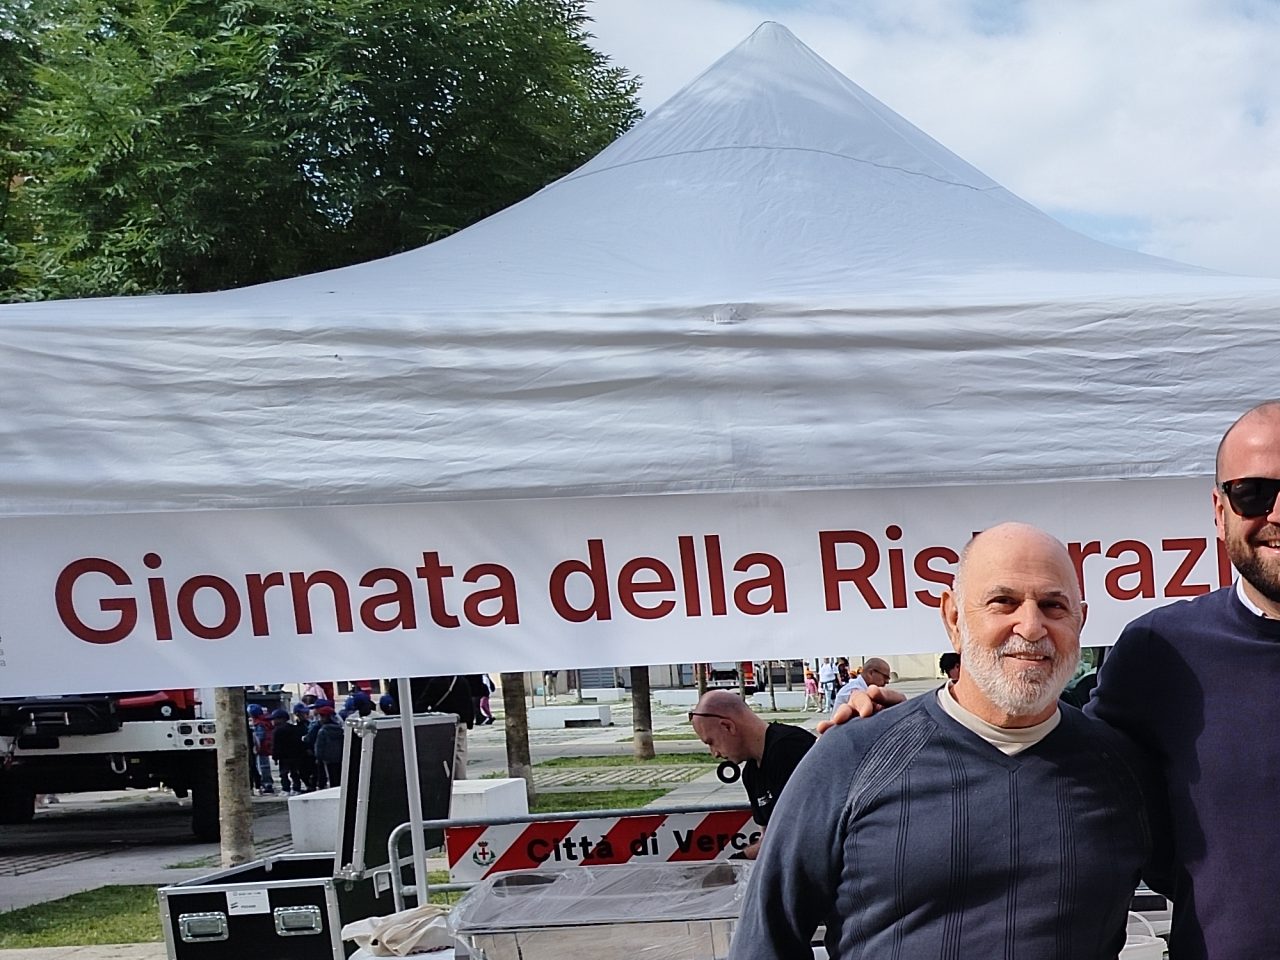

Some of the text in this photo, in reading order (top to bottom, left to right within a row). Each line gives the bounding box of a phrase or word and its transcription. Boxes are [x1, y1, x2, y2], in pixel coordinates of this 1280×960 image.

[54, 551, 520, 645] Giornata
[549, 534, 789, 623] della
[527, 829, 762, 863] Città di Verce
